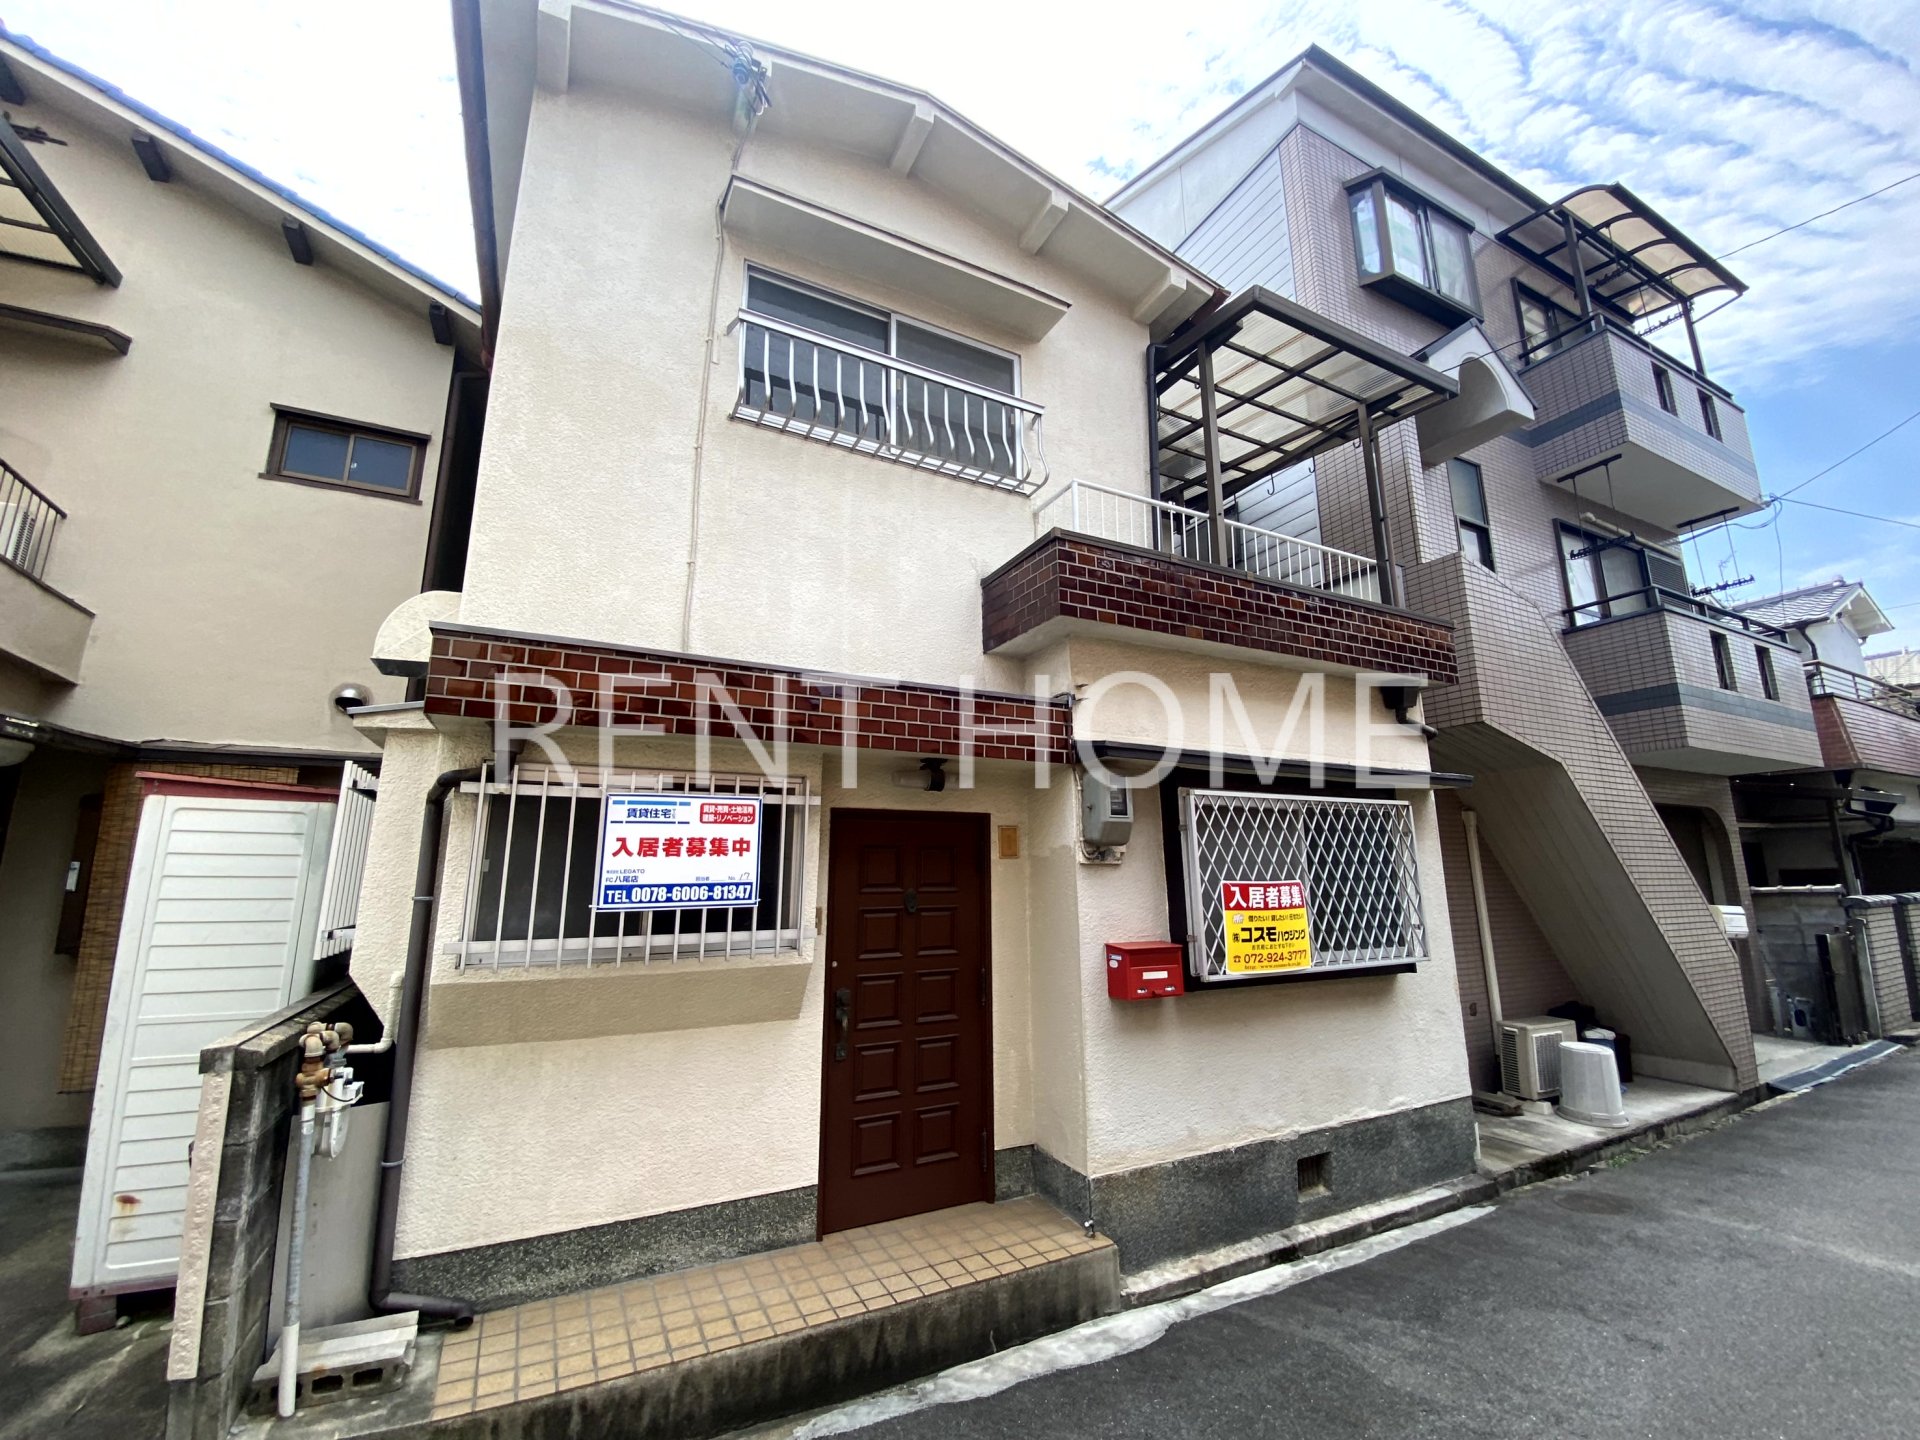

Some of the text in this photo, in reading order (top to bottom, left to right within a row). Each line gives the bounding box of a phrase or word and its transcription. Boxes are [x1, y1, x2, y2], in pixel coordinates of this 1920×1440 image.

[626, 807, 672, 819] 賃貸住宅
[612, 837, 751, 858] 入居者募集中
[614, 875, 639, 883] 八尾店
[606, 884, 751, 903] TEL 0078-6006-81347
[1228, 885, 1303, 909] 入居者募集
[1243, 949, 1307, 964] 072-924-3777
